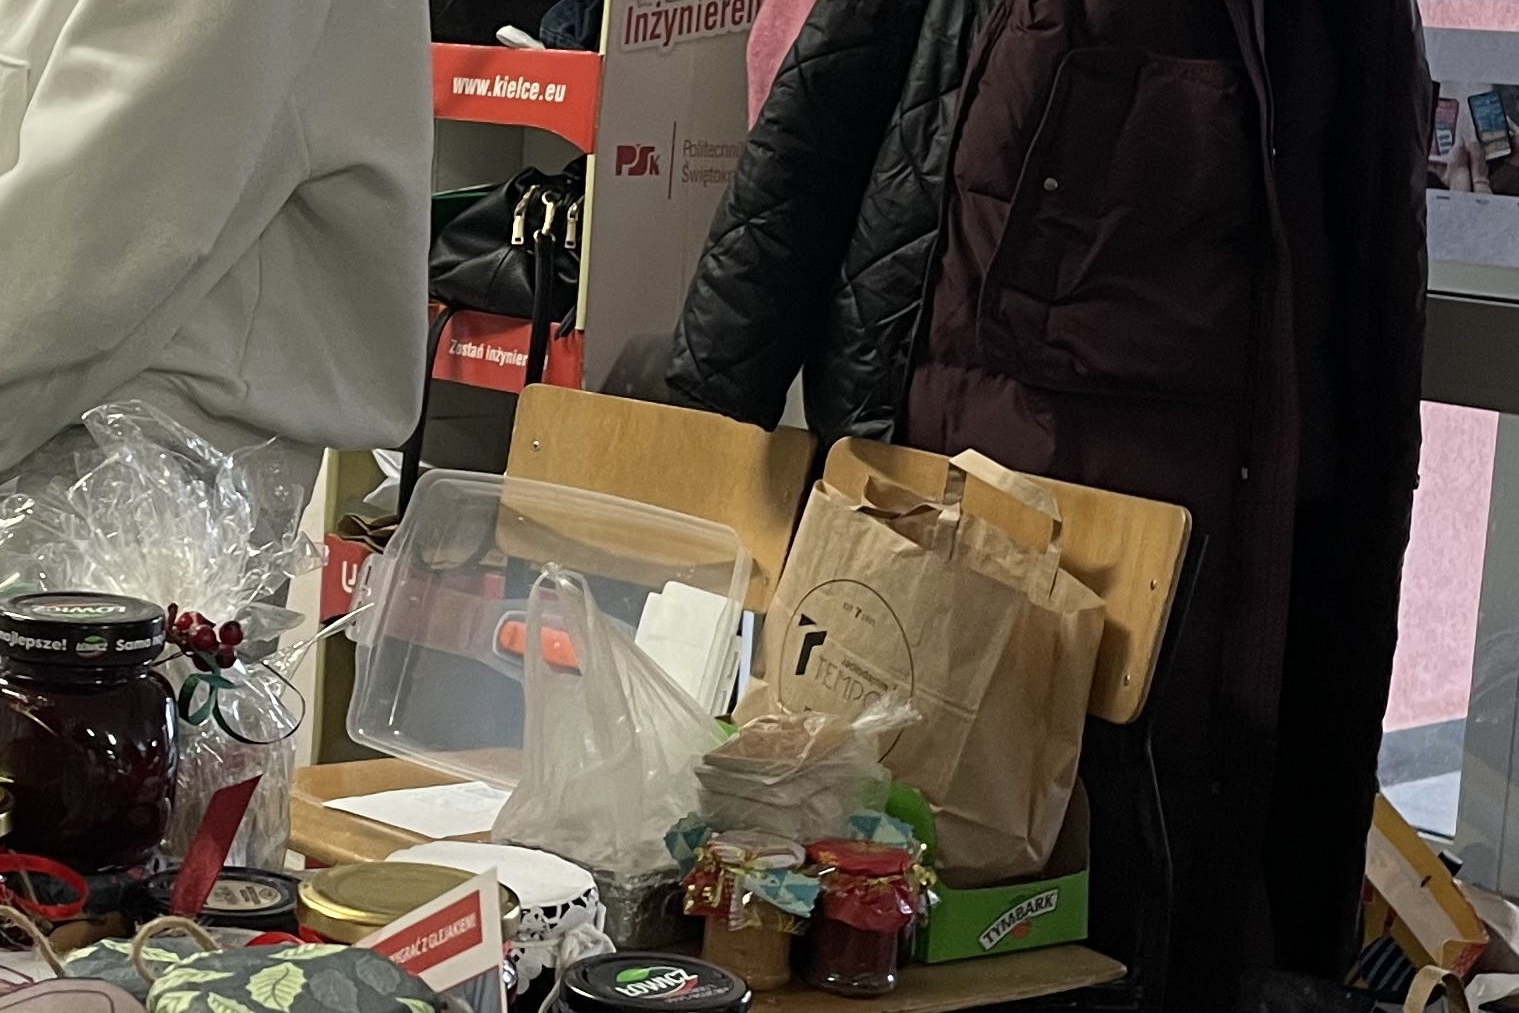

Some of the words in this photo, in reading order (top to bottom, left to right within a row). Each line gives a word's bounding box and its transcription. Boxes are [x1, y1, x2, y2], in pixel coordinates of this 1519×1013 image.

[452, 74, 567, 103] www.kielce.eu
[449, 339, 484, 359] Zostań
[115, 638, 151, 651] Sama
[982, 892, 1056, 944] TYMBARK
[615, 969, 698, 997] ŁOWICZ
